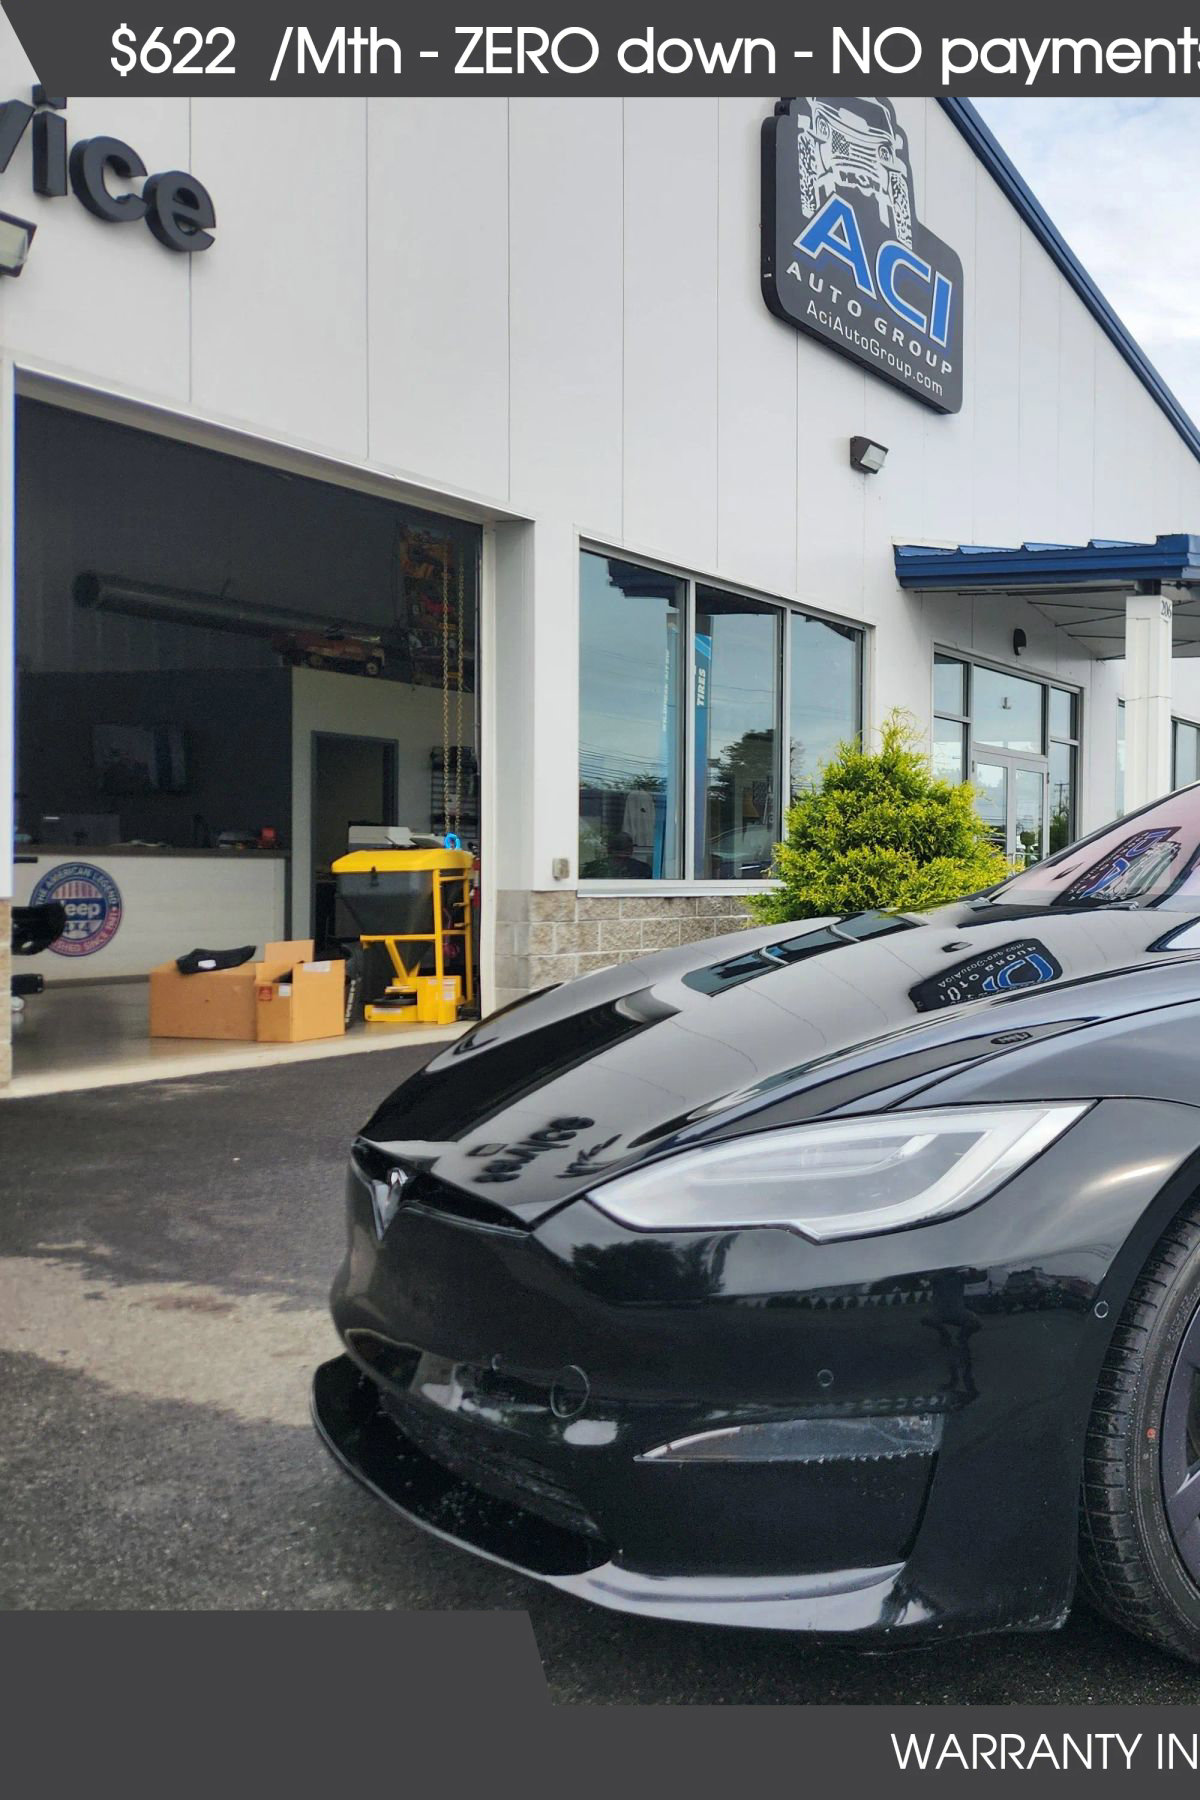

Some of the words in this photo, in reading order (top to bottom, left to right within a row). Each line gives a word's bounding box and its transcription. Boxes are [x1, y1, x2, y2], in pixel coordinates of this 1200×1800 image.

[786, 261, 862, 318] AUTO
[874, 317, 953, 375] GROUP
[793, 192, 953, 348] ACI
[806, 300, 943, 397] AciAutoGroup.com
[696, 668, 706, 706] TIRES
[61, 900, 100, 919] eep
